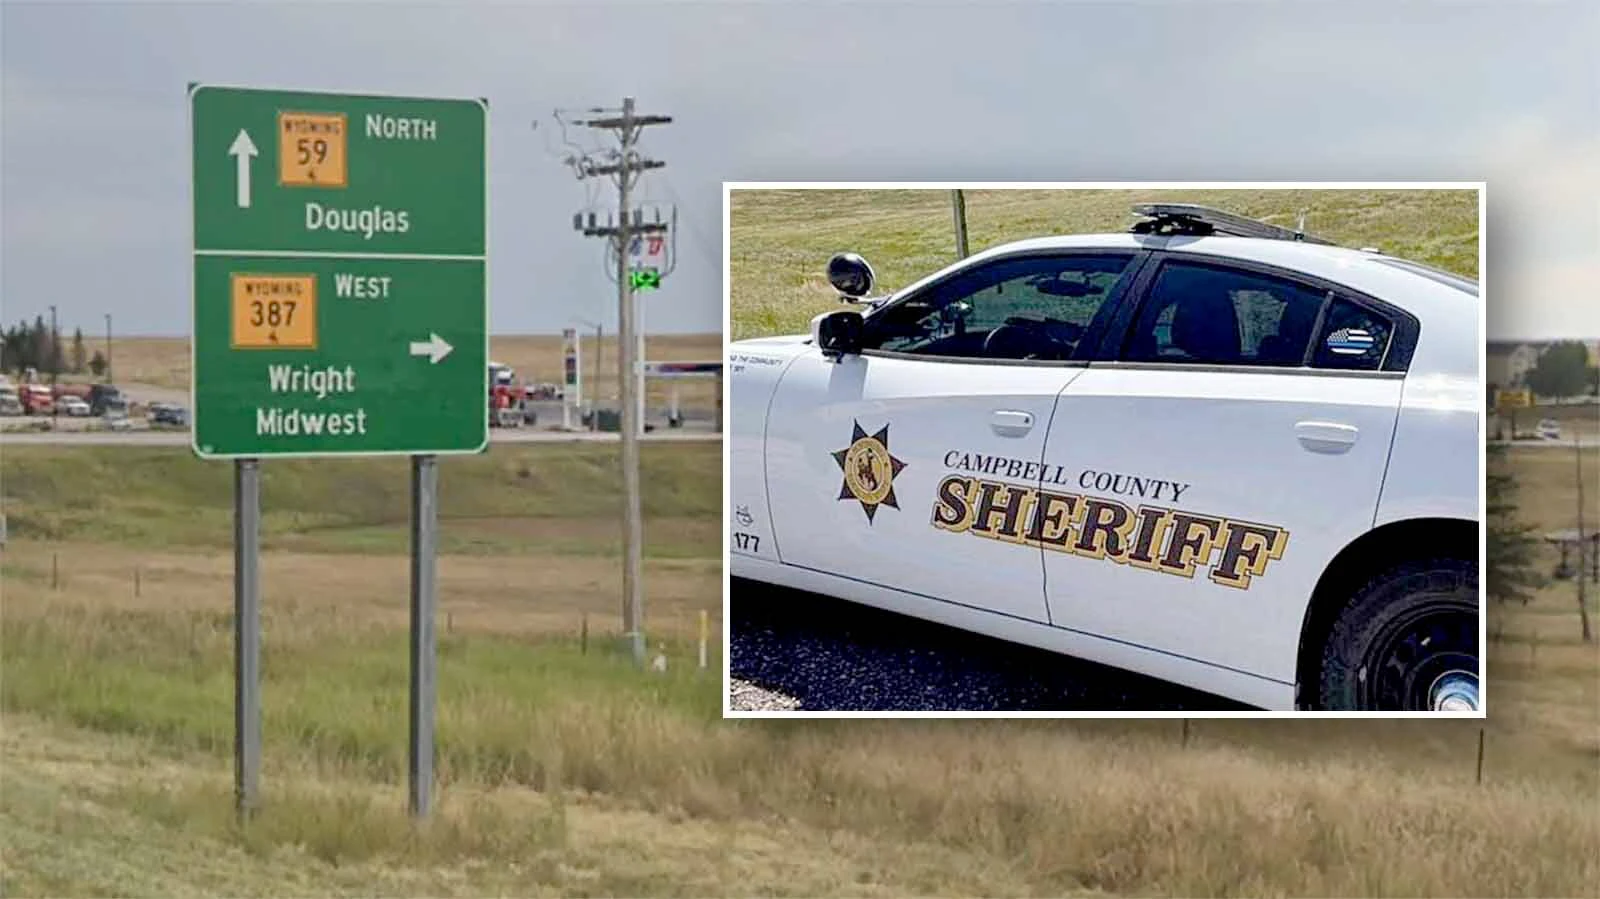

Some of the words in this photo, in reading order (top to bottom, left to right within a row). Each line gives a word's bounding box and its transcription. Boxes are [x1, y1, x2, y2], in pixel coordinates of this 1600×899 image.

[284, 120, 341, 135] WYOMING
[366, 114, 437, 140] NORTH
[297, 140, 328, 166] 59
[305, 203, 409, 240] Douglas
[245, 282, 302, 296] WYOMING
[335, 273, 392, 298] WEST
[250, 301, 297, 328] 387
[269, 365, 356, 399] Wright
[256, 408, 367, 435] Midwest
[944, 450, 1067, 486] CAMPBELL
[1079, 469, 1191, 503] COUNTY
[733, 532, 760, 552] 177
[932, 474, 1290, 591] SHERIFF
